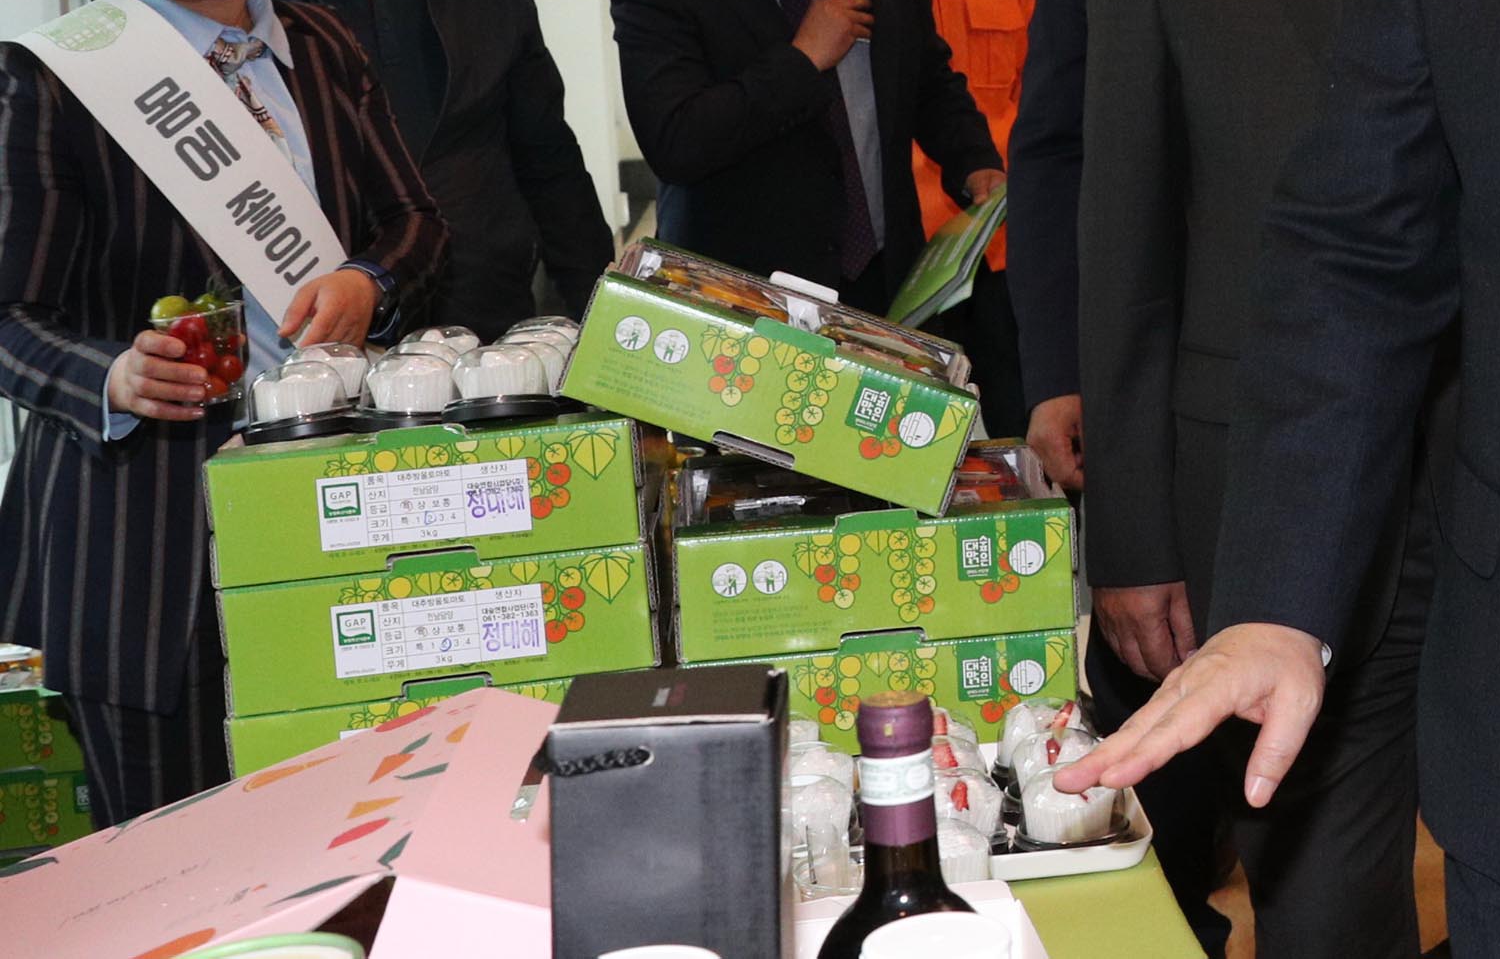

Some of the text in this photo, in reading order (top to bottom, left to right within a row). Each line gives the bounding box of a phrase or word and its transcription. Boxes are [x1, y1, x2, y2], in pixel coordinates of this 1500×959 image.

[134, 76, 319, 286] 몸에 좋은
[329, 490, 352, 500] GAP
[344, 617, 366, 628] GAP
